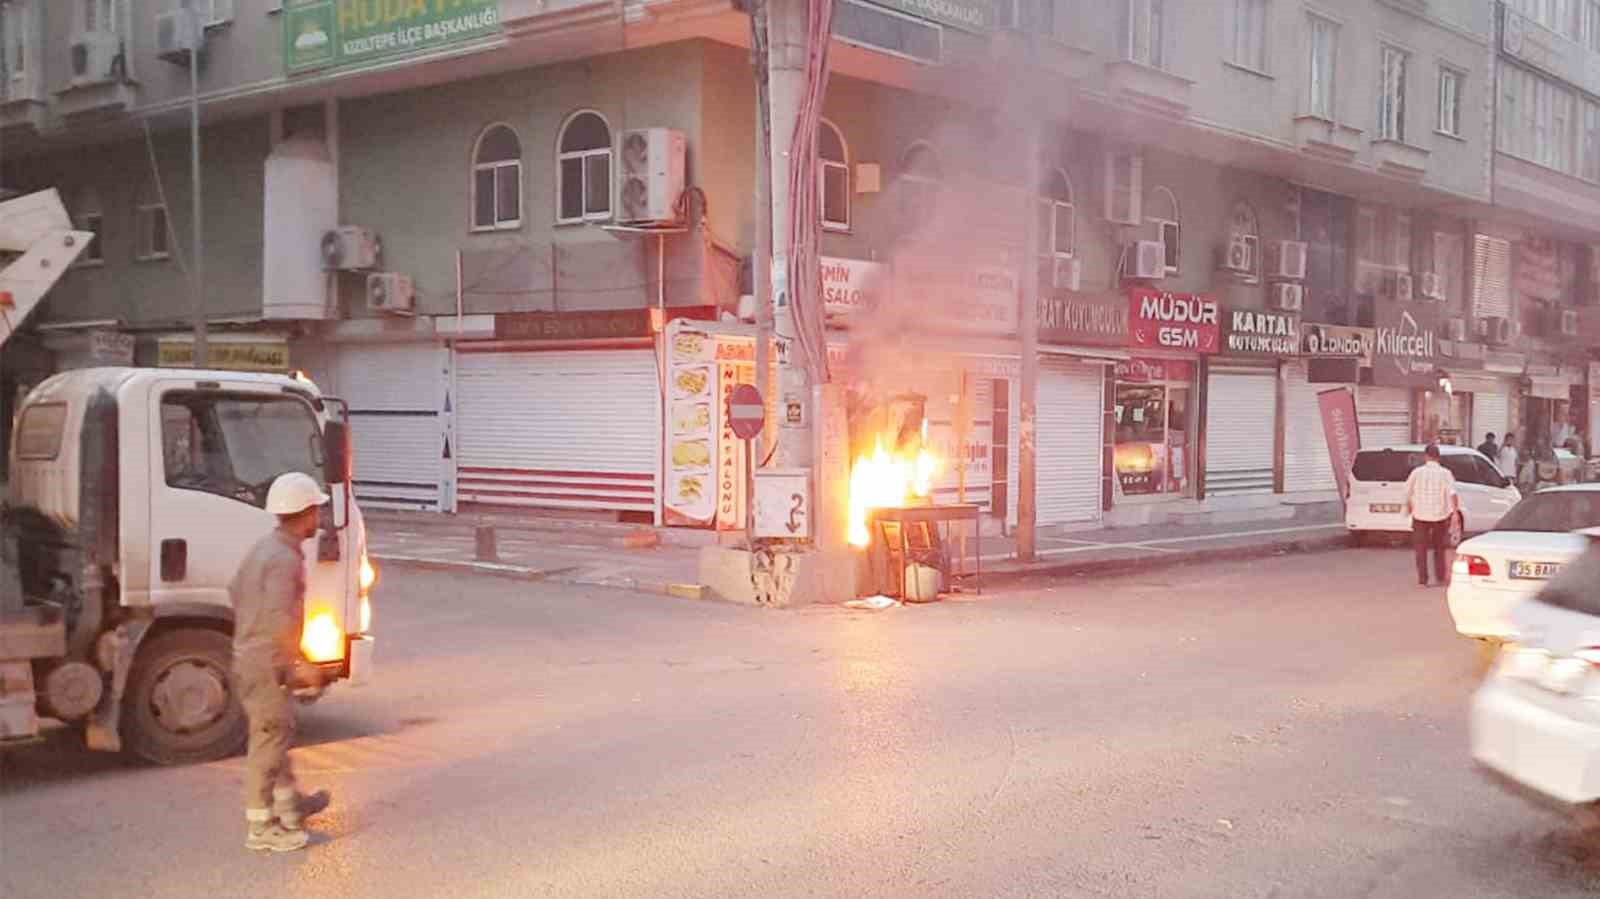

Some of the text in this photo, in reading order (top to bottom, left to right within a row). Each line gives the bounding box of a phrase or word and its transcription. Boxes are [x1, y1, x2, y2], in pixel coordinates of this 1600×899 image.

[424, 8, 498, 40] BAŞKANLIĞI
[1139, 292, 1218, 325] MÜDÜR
[1158, 326, 1199, 347] GSM
[1232, 311, 1297, 337] KARTAL
